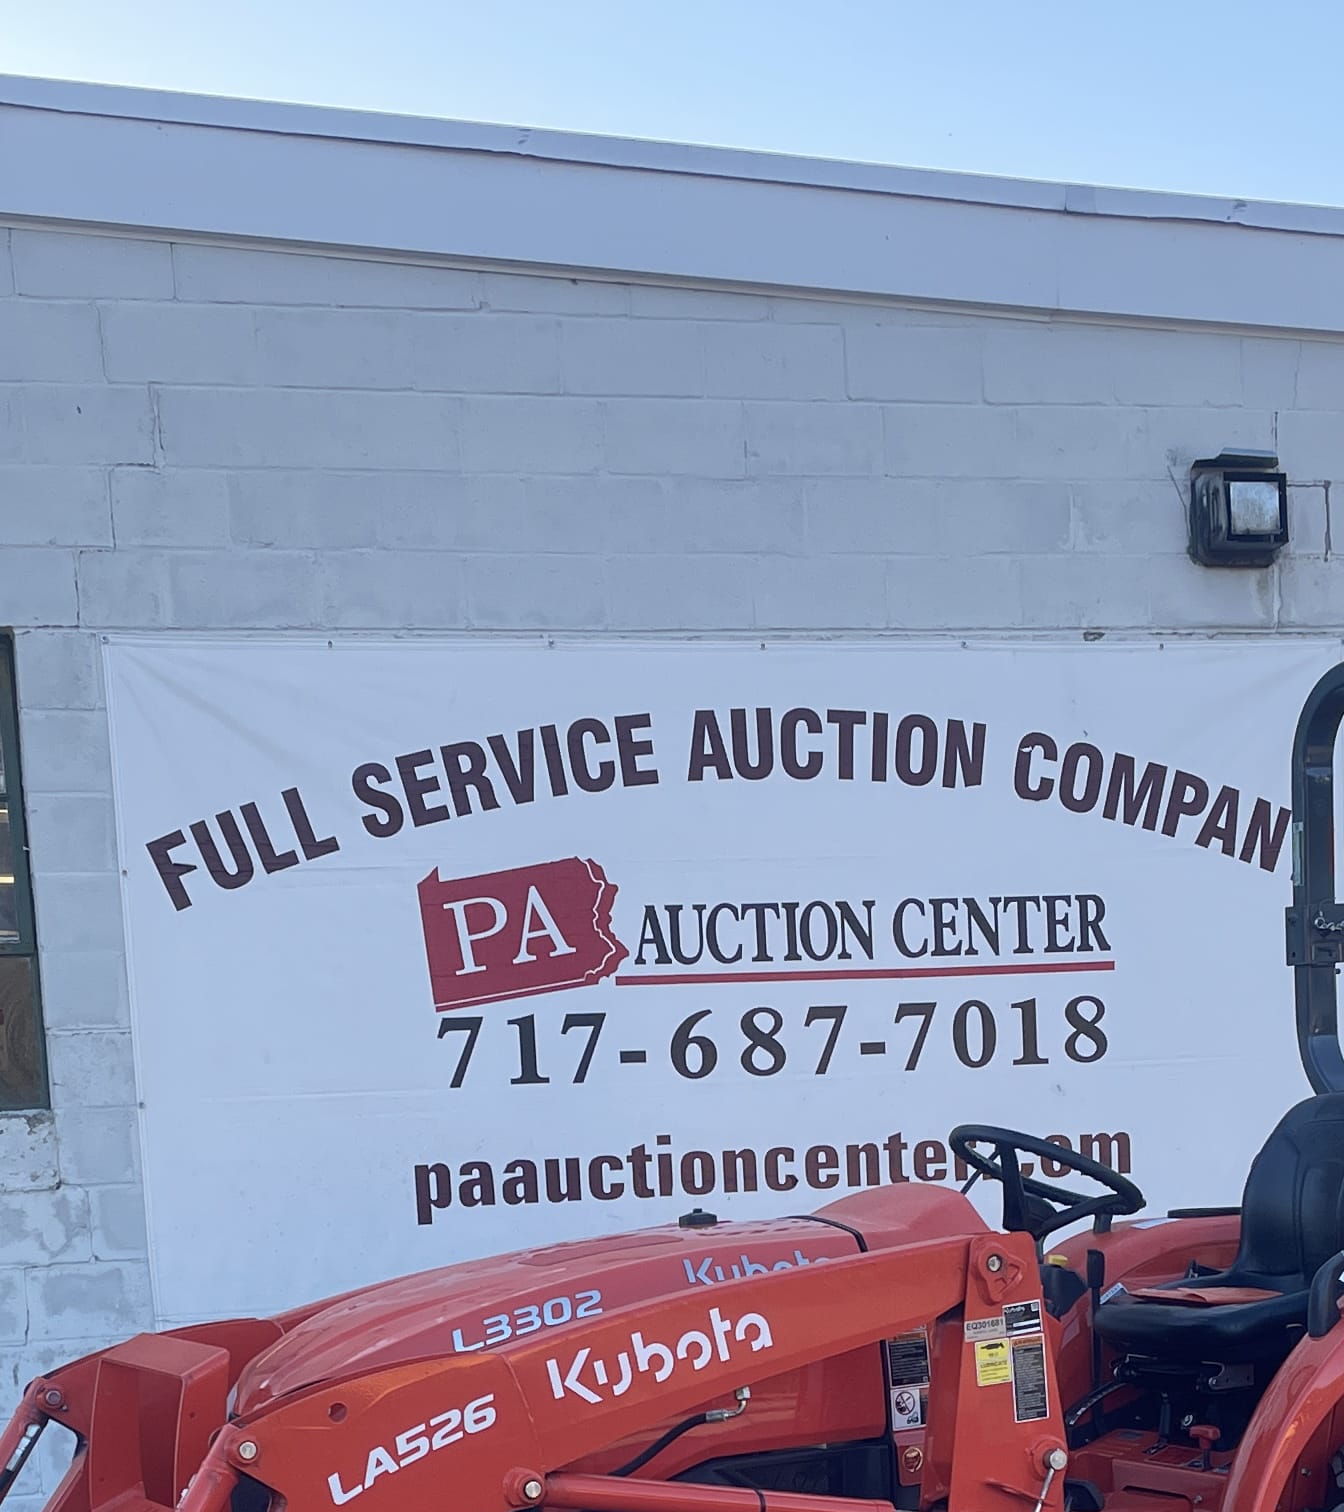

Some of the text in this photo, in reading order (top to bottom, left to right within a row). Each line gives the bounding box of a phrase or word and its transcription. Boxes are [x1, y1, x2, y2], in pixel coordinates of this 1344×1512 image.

[145, 706, 1294, 912] FULL SERVICE AUCTION COMPAN
[442, 885, 1112, 976] PA AUCTION CENTER
[436, 994, 1109, 1089] 717-687-7018
[682, 1250, 831, 1286] Kubt
[452, 1289, 604, 1353] L3302
[546, 1307, 774, 1404] Kubota
[327, 1392, 498, 1507] LA526
